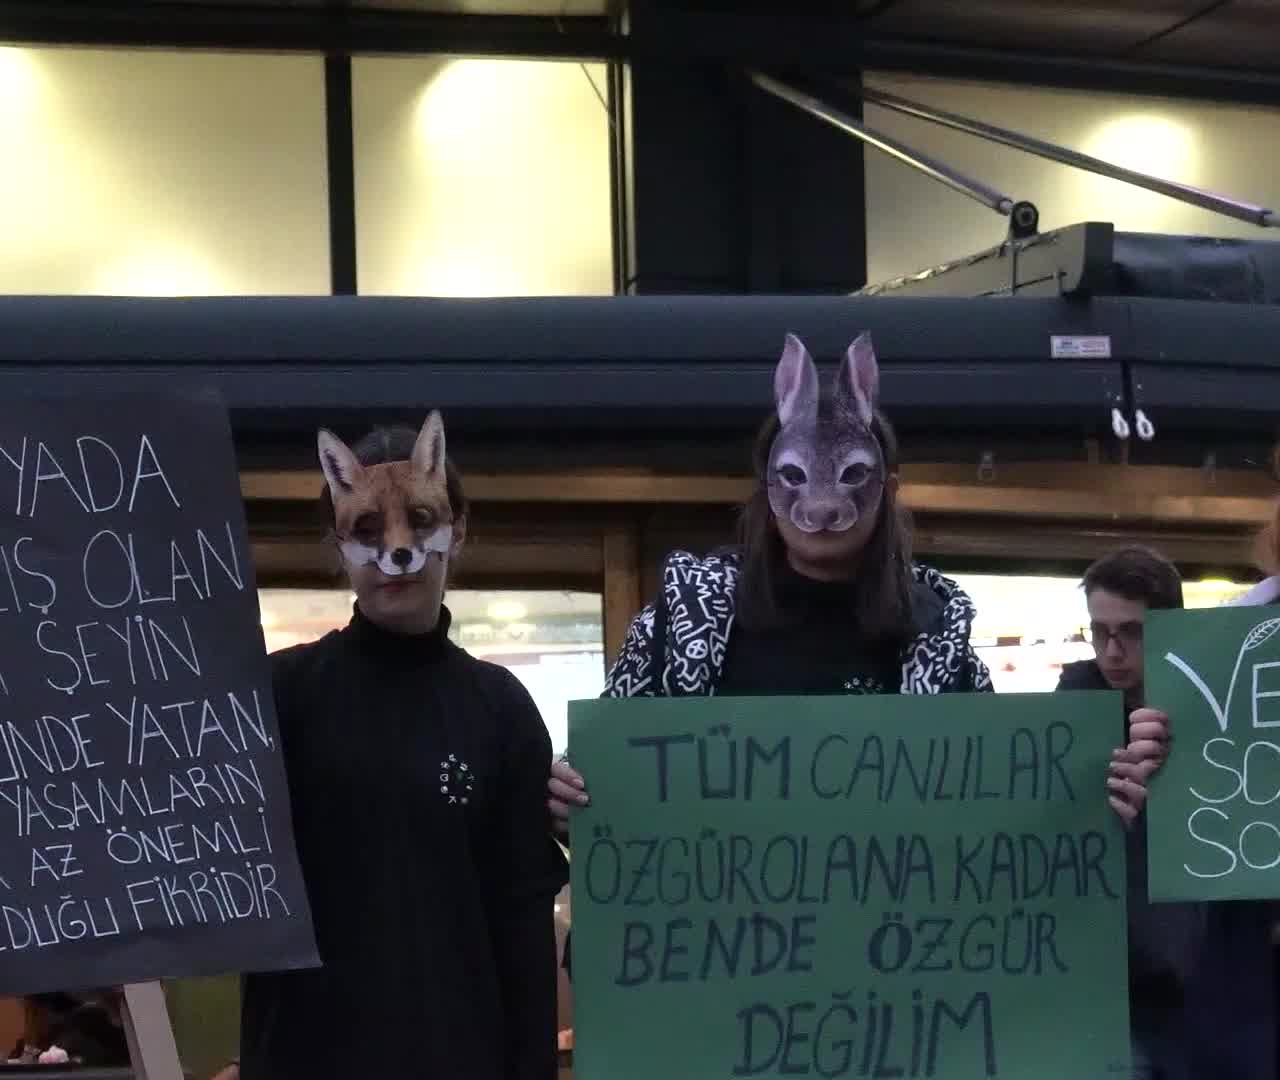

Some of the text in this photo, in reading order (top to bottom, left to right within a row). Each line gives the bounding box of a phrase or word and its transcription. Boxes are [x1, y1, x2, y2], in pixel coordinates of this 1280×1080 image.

[83, 522, 245, 608] OLAN
[37, 614, 202, 695] ŞEYİN
[626, 719, 1078, 803] TÜM CANLILAR
[30, 844, 84, 888] AZ
[106, 806, 274, 866] ÖNEMLİ
[953, 830, 1123, 904] KADAR
[127, 861, 292, 933] FİKRİDİR
[868, 908, 1070, 975] ÖZGÜR
[732, 989, 999, 1080] DEĞİLİM
